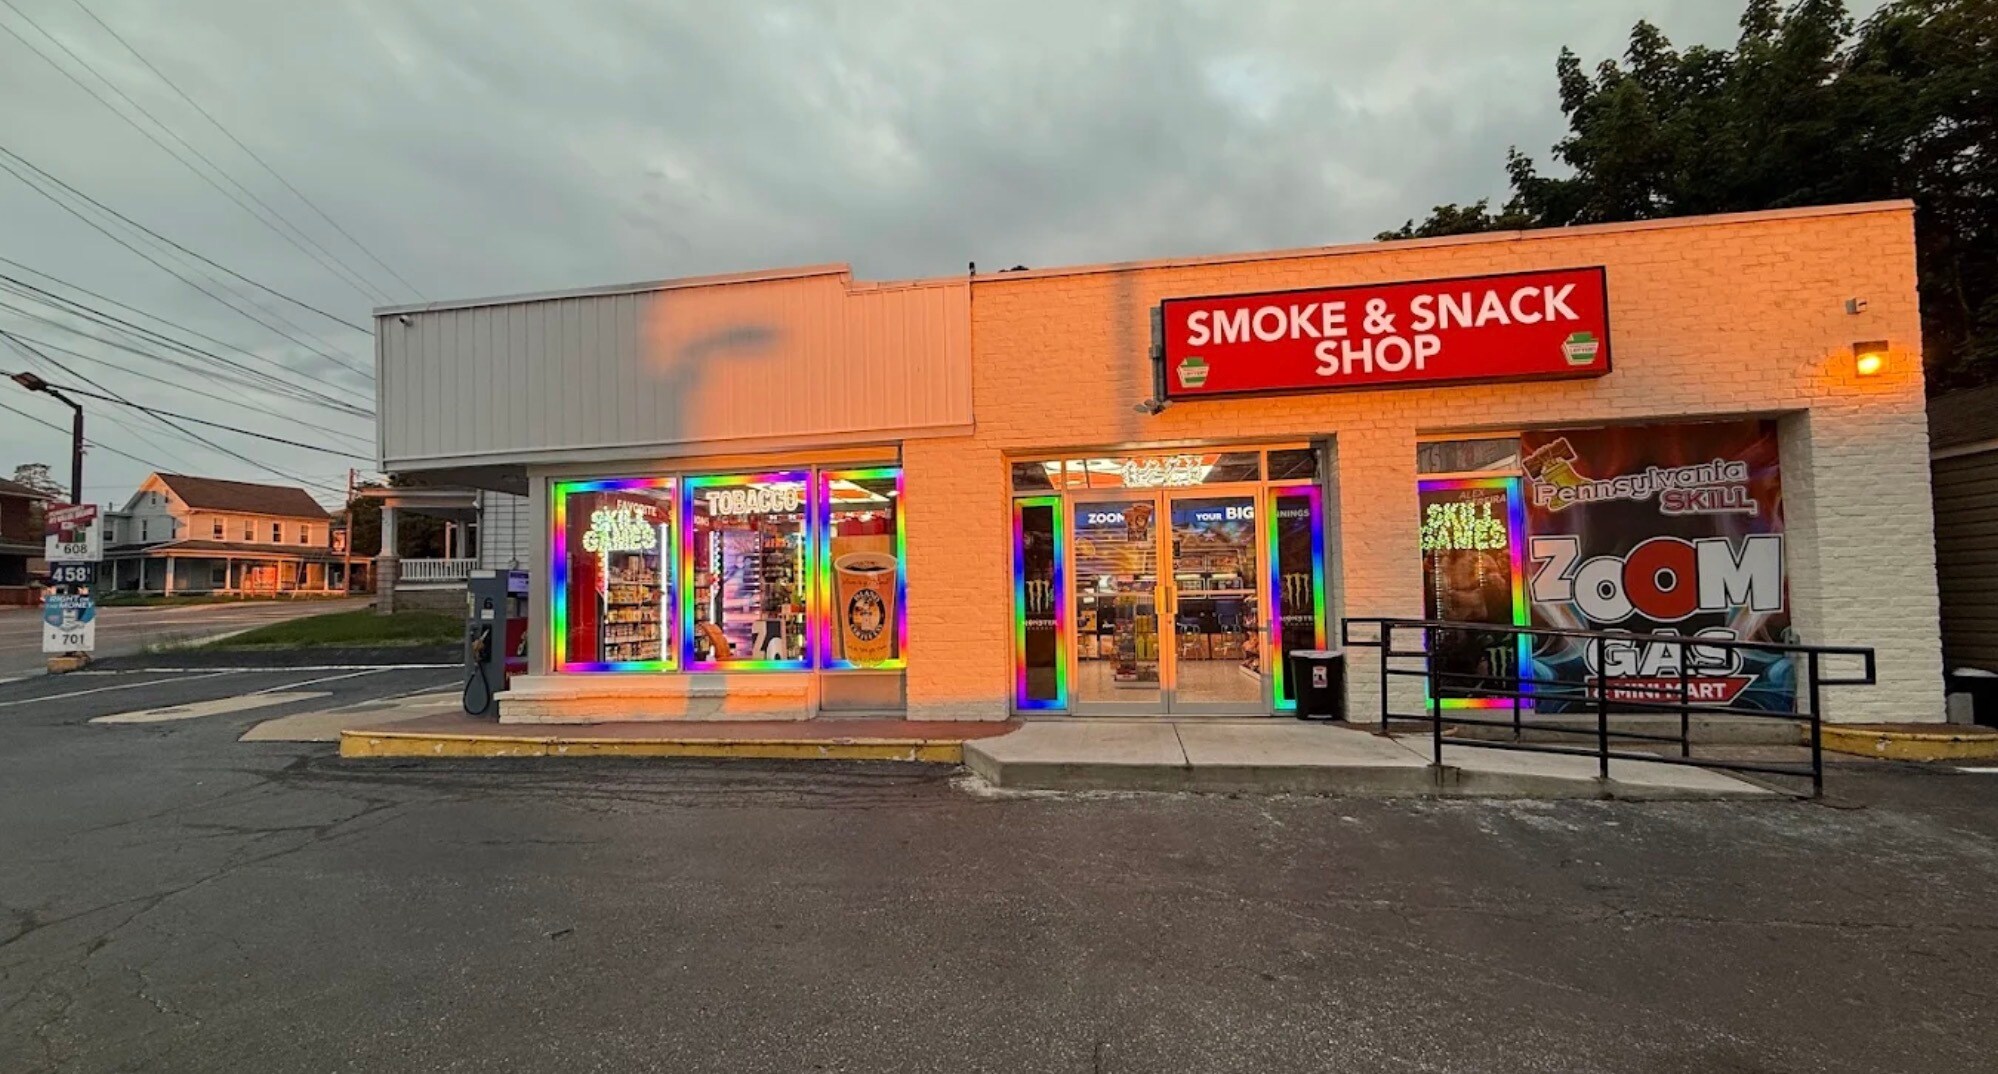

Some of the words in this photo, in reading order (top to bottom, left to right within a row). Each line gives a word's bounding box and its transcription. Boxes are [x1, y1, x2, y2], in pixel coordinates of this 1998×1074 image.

[1186, 300, 1348, 347] SMOKE
[1362, 298, 1397, 335] &
[1409, 283, 1579, 332] SNACK
[1315, 333, 1442, 377] SHOP
[1534, 458, 1749, 506] Pennsylvania
[705, 488, 799, 516] TOBACCO
[1225, 507, 1254, 520] BIG
[1426, 502, 1492, 527] SKILL
[1660, 486, 1757, 516] SKILL
[1195, 512, 1222, 522] YOUR
[64, 543, 88, 554] 608
[582, 524, 657, 552] GAMES
[1420, 519, 1507, 550] GAMES
[52, 567, 87, 582] 458
[1529, 533, 1784, 624] ZOOM
[484, 597, 494, 610] 6
[62, 633, 84, 645] 701
[1584, 627, 1744, 678] GAS
[1614, 683, 1660, 699] MINI
[1666, 683, 1727, 699] MART
